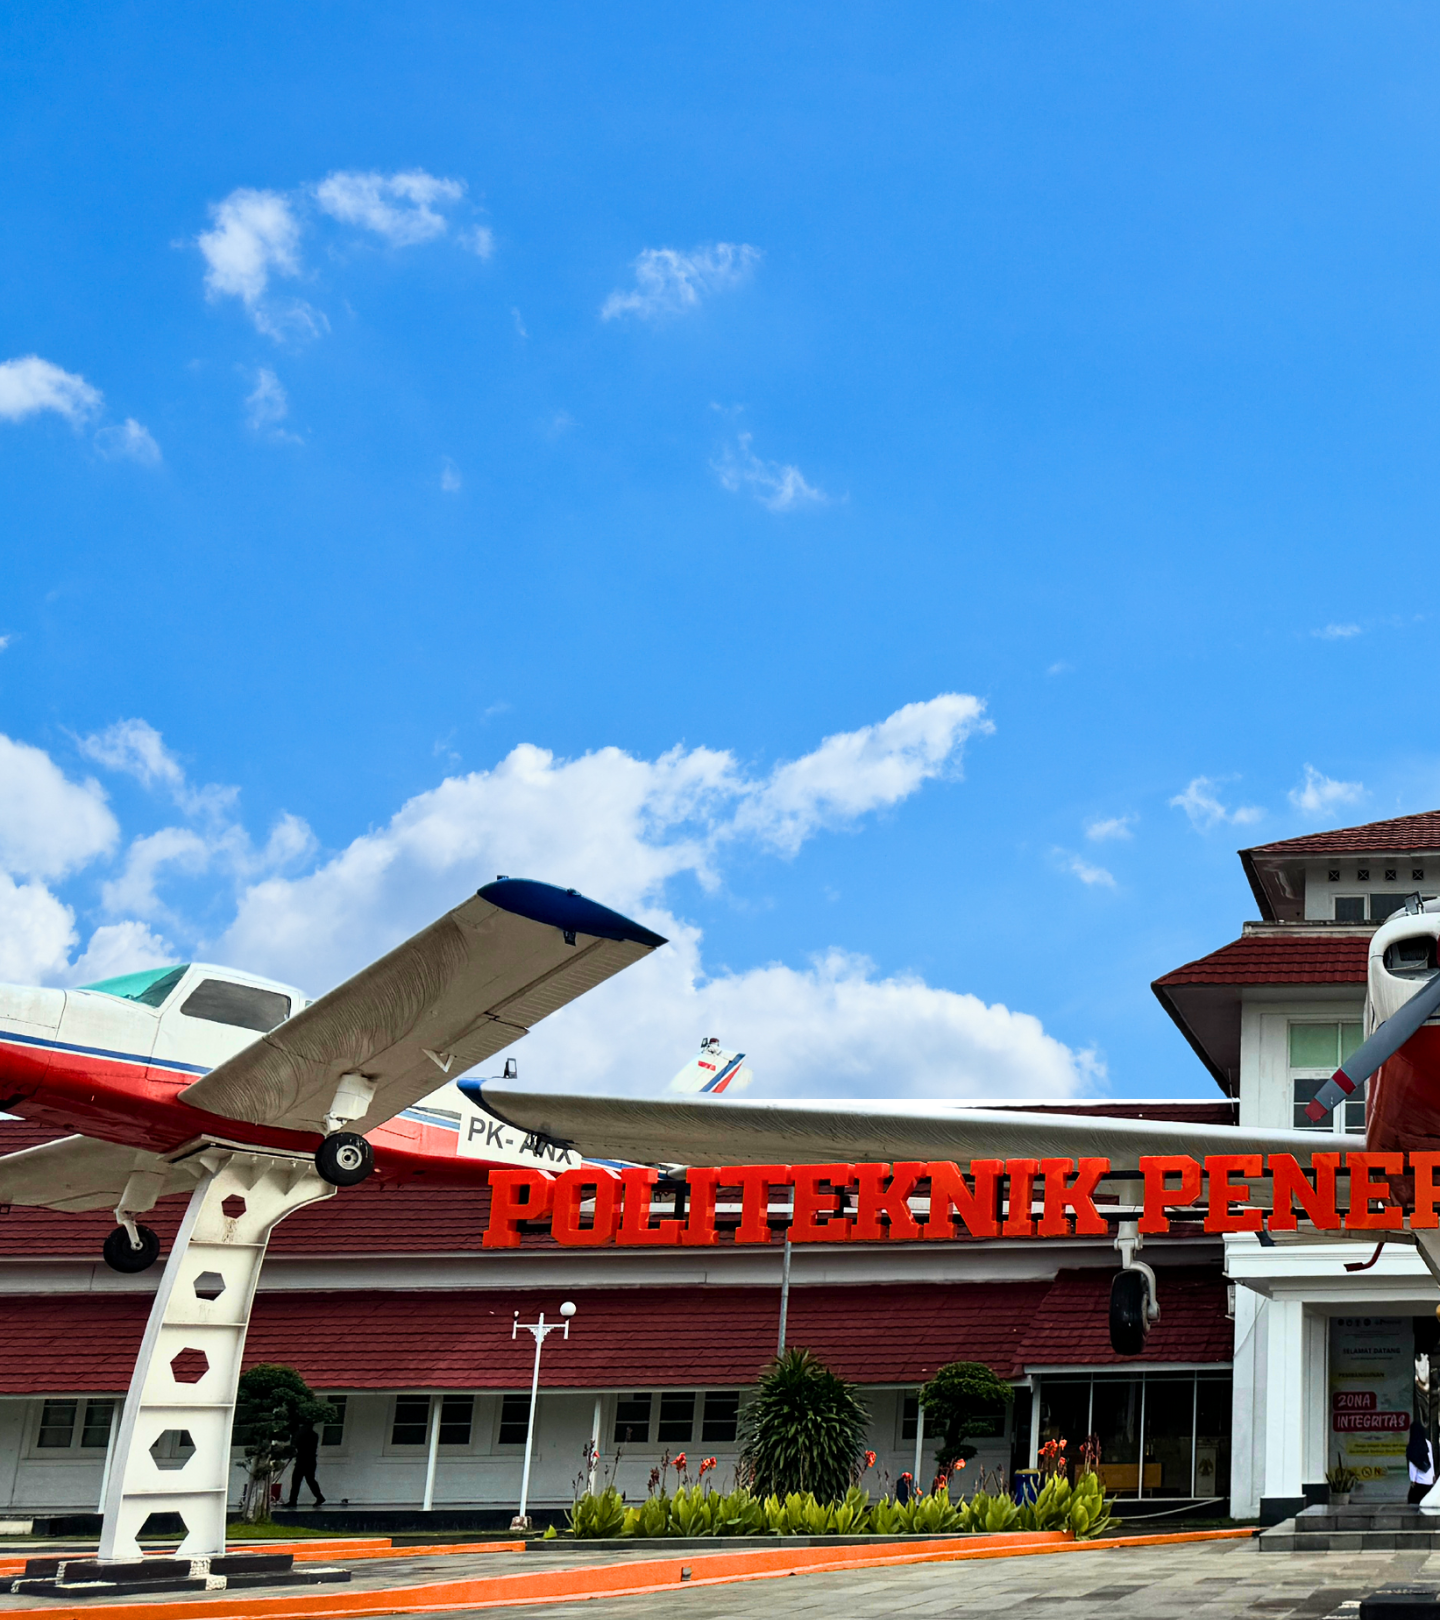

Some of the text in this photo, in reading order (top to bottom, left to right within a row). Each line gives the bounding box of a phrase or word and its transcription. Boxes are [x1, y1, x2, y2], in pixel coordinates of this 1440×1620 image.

[482, 1157, 1110, 1248] POLITEKNIK
[1343, 1347, 1372, 1355] SELAMAT
[1337, 1414, 1406, 1429] INTEGRITAS
